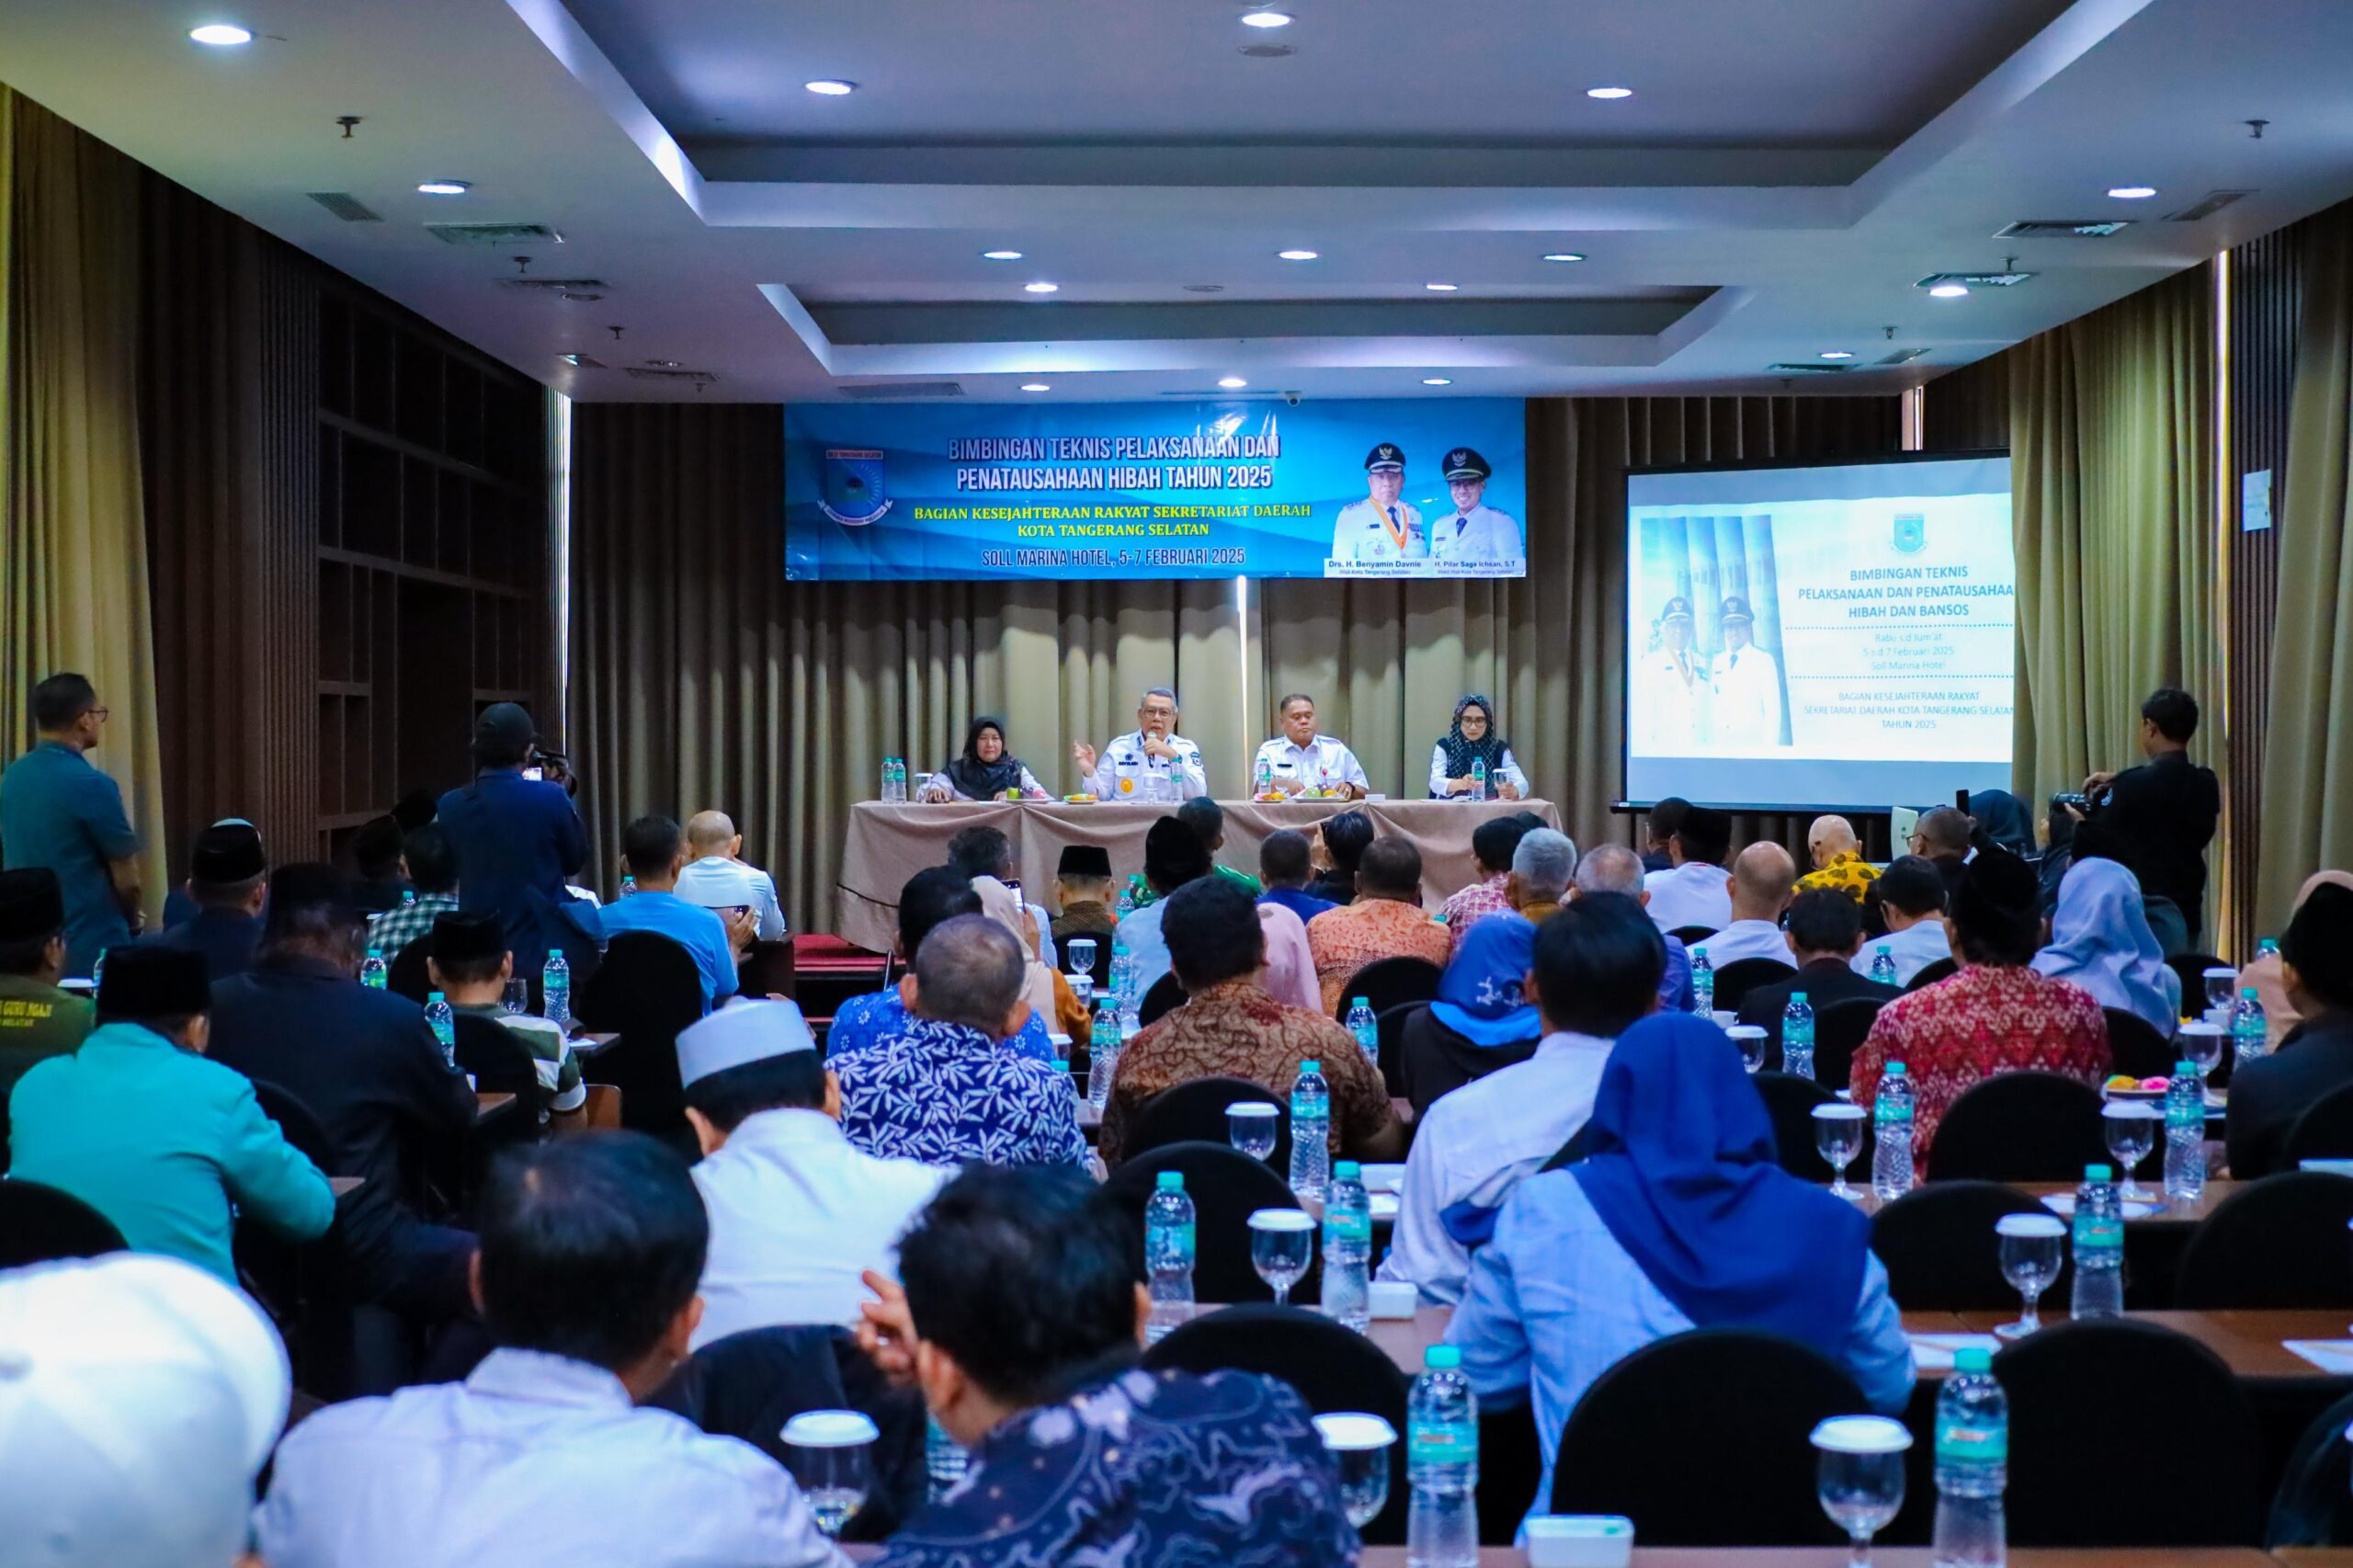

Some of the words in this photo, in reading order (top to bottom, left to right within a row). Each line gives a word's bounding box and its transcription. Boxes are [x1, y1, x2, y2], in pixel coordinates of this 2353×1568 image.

[949, 437, 1046, 461] BIMBINGAN
[1050, 437, 1111, 460] TEKNIS
[1115, 435, 1240, 460] PELAKSANAAN
[1245, 434, 1281, 459] DAN
[957, 466, 1104, 491] PENATAUSAHAAN
[1108, 466, 1163, 490] HIBAH
[1165, 465, 1223, 489] TAHUN
[1226, 464, 1273, 489] 2025
[915, 507, 968, 520] BAGIAN
[972, 506, 1091, 521] KESEJAHTERAAN
[1094, 506, 1150, 518] RAKYAT
[1154, 506, 1249, 518] SEKRETARIAT
[1254, 505, 1312, 517] DAERAH
[1017, 525, 1055, 537] KOTA
[1059, 525, 1145, 537] TANGERANG
[1149, 524, 1210, 536] SELATAN
[982, 549, 1013, 567] SOLL
[1017, 549, 1068, 566] MARINA
[1072, 549, 1116, 568] HOTEL,
[1120, 549, 1142, 565] 5-7
[1145, 549, 1208, 565] FEBRUARI
[1211, 548, 1245, 564] 2025
[1356, 561, 1393, 569] Benyamin
[1849, 567, 1922, 581] BIMBINGAN
[1926, 566, 1969, 578] TEKNIS
[1798, 587, 1883, 599] PELAKSANAAN
[1886, 586, 1912, 598] DAN
[1848, 606, 1887, 618] HIBAH
[1890, 606, 1916, 617] DAN
[1919, 604, 1970, 616] BANSOS
[1875, 633, 1897, 642] Rabu
[1914, 632, 1942, 642] Jum'at
[1893, 647, 1929, 656] Februari
[1932, 646, 1955, 655] 2025
[1871, 662, 1887, 670] Soll
[1889, 662, 1920, 670] Marina
[1922, 660, 1946, 669] Hotel
[1838, 692, 1871, 700] BAGIAN
[1874, 691, 1945, 700] KESEJAHTERAAN
[1948, 691, 1980, 700] RAKYAT
[1803, 706, 1857, 714] SEKRETARIAT
[1859, 706, 1895, 714] DAERAH
[1897, 706, 1920, 714] KOTA
[1923, 706, 1977, 714] TANGERANG
[1881, 720, 1912, 729] TAHUN
[1915, 720, 1936, 729] 2025
